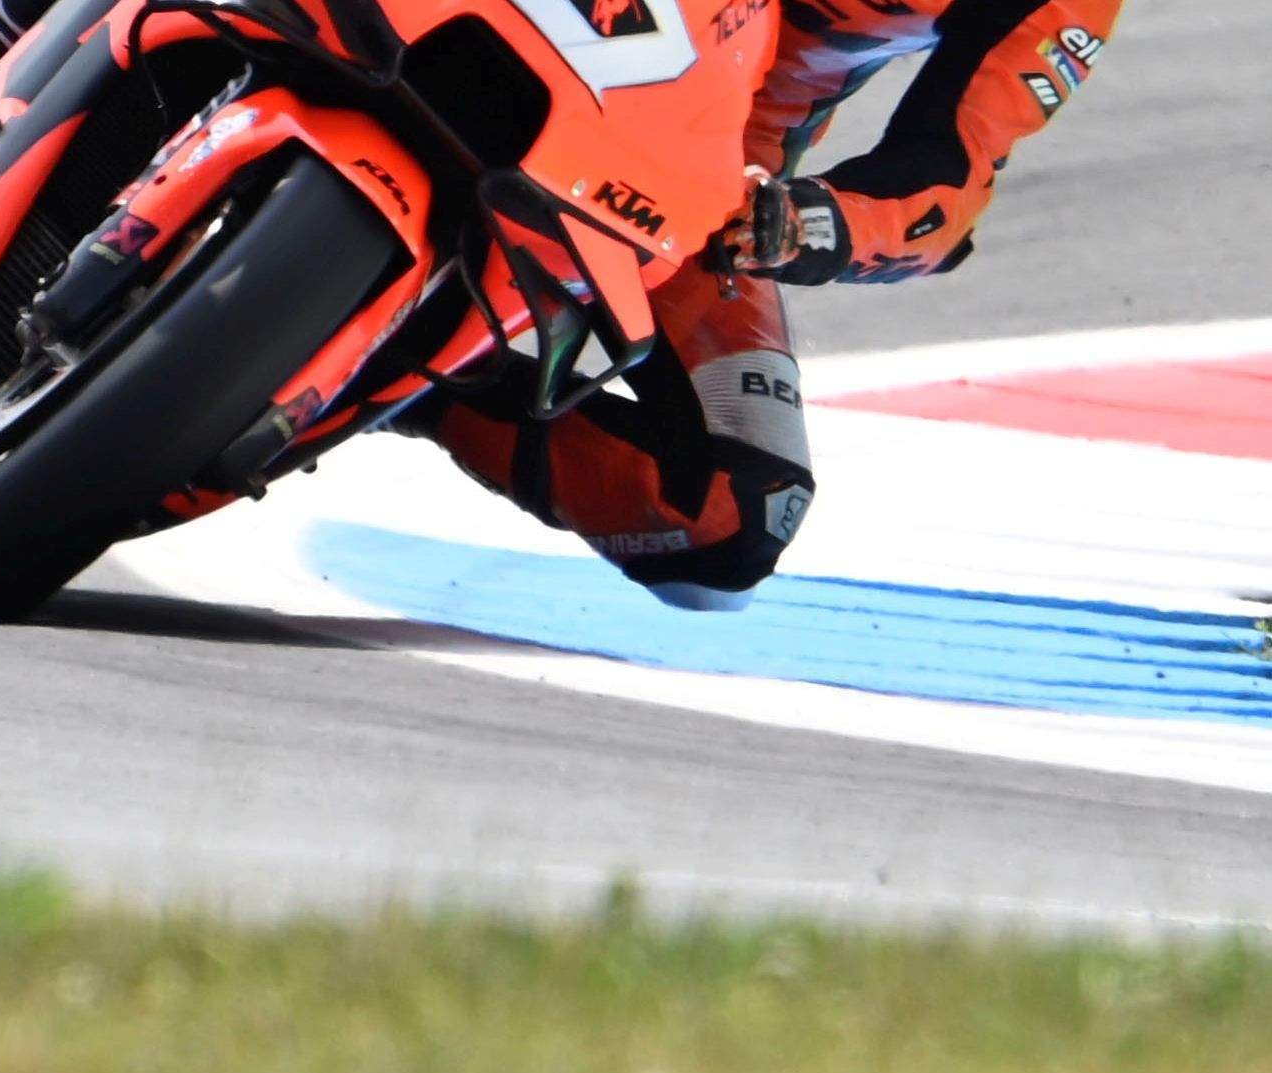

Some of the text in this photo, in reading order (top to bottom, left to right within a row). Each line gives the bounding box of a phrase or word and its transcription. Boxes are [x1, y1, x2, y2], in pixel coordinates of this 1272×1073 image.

[1059, 26, 1105, 69] el
[350, 157, 411, 217] KTM
[594, 179, 665, 237] KTM
